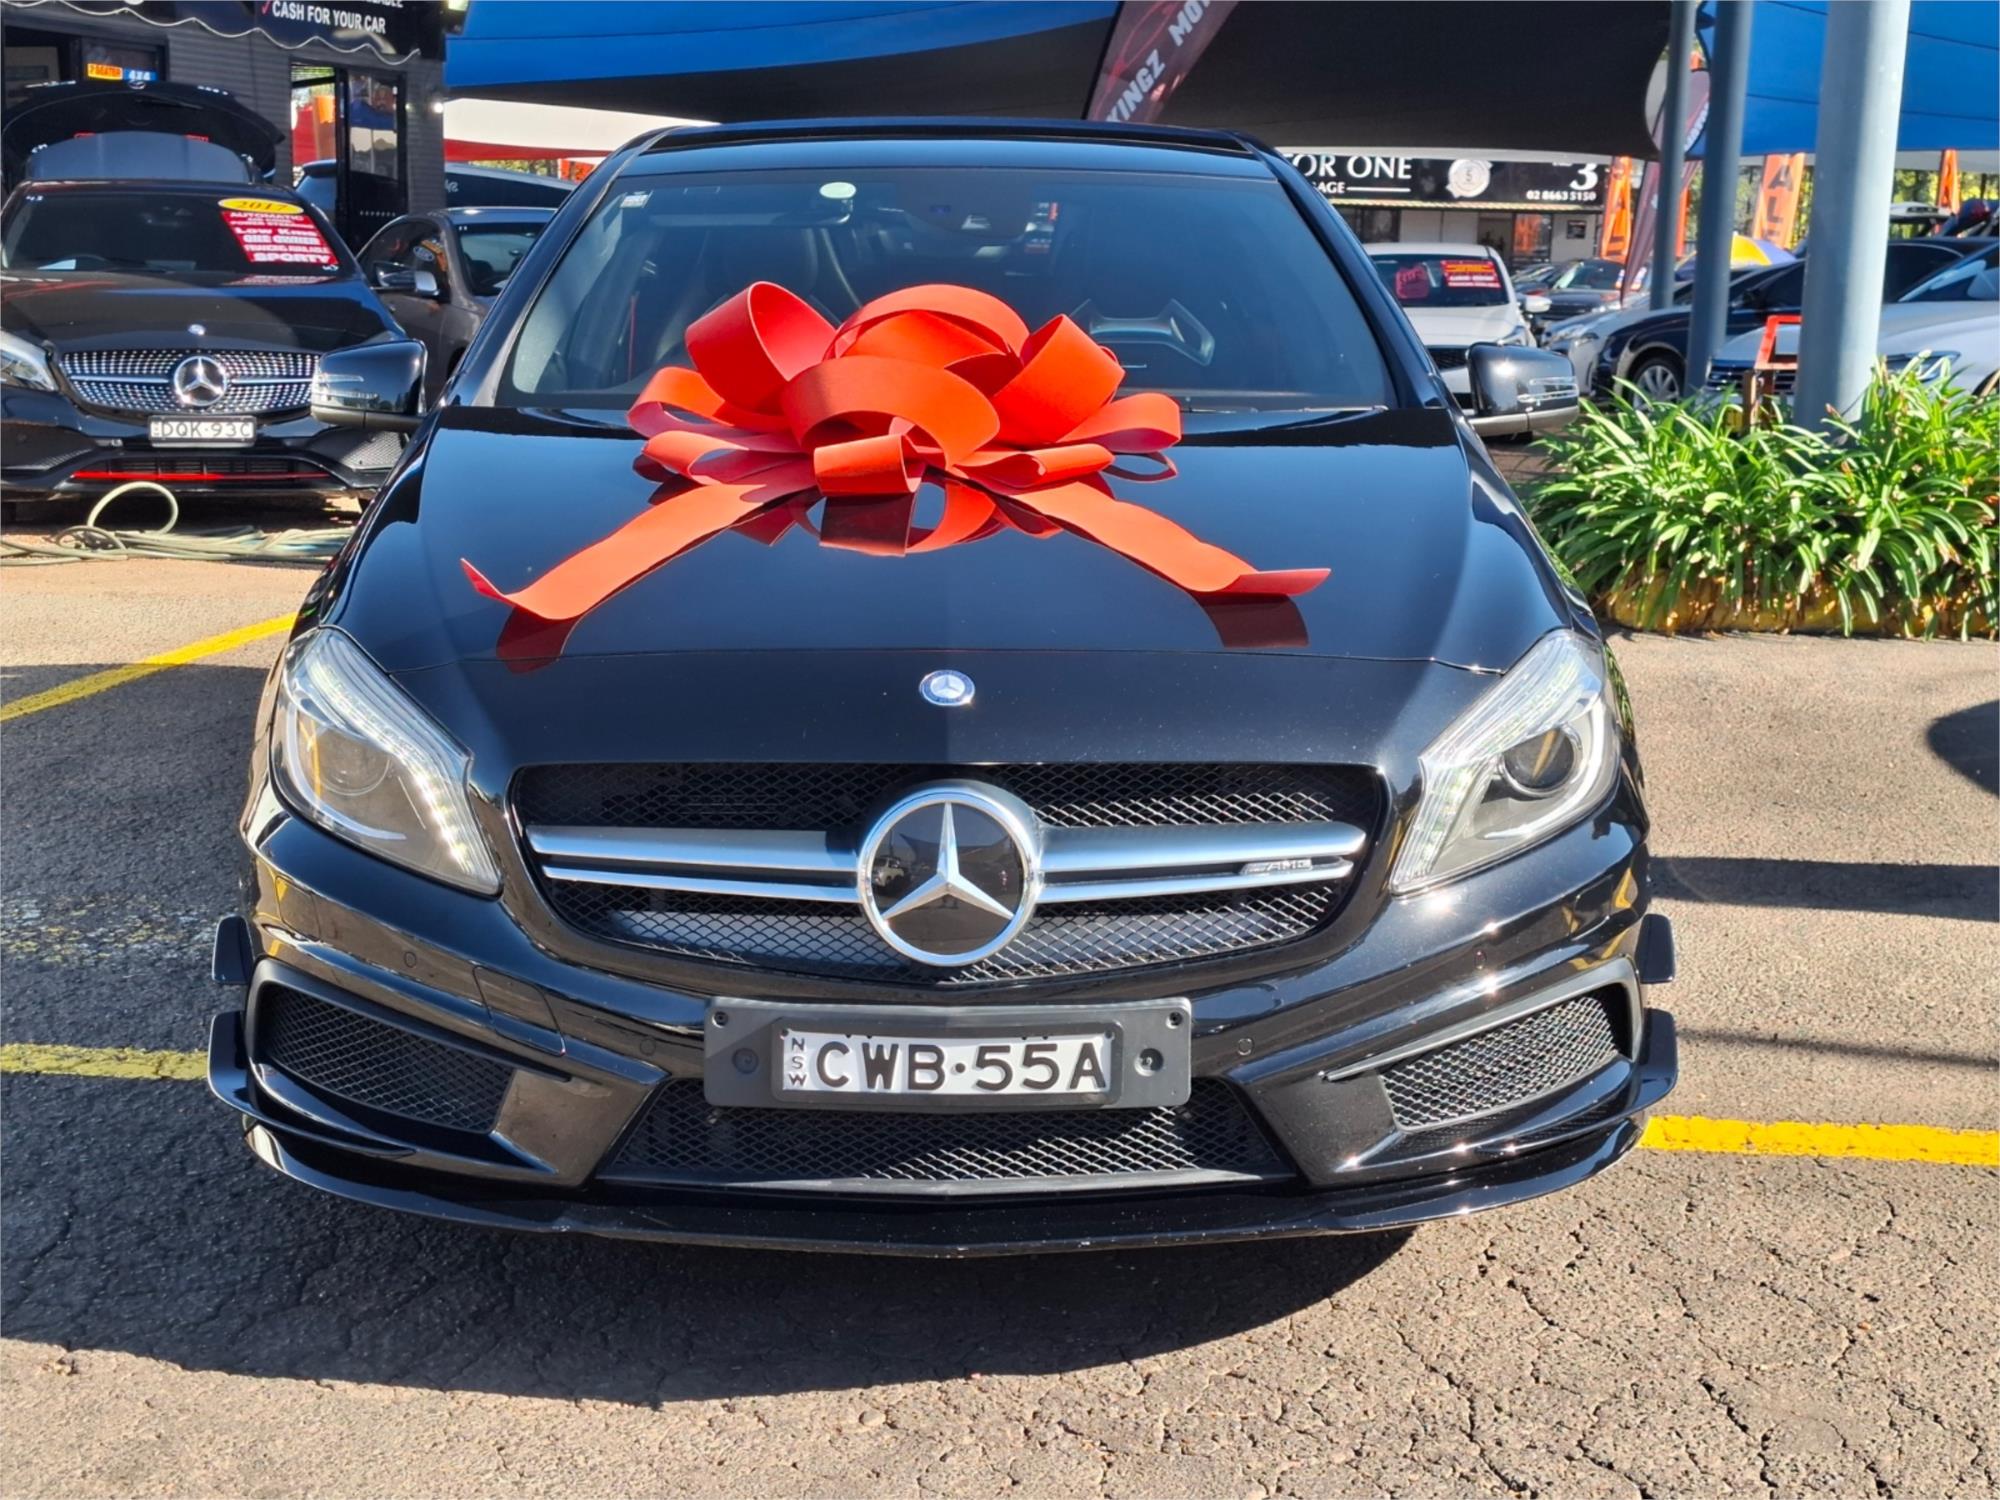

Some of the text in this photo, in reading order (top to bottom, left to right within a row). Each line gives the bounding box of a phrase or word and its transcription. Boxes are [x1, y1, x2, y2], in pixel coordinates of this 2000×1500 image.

[272, 1, 386, 34] CASH FOR YOUR CAR
[1346, 155, 1412, 179] ONE
[1569, 162, 1599, 190] 3
[1526, 190, 1540, 200] 02
[237, 201, 288, 211] 2017
[253, 252, 331, 264] SPORTY
